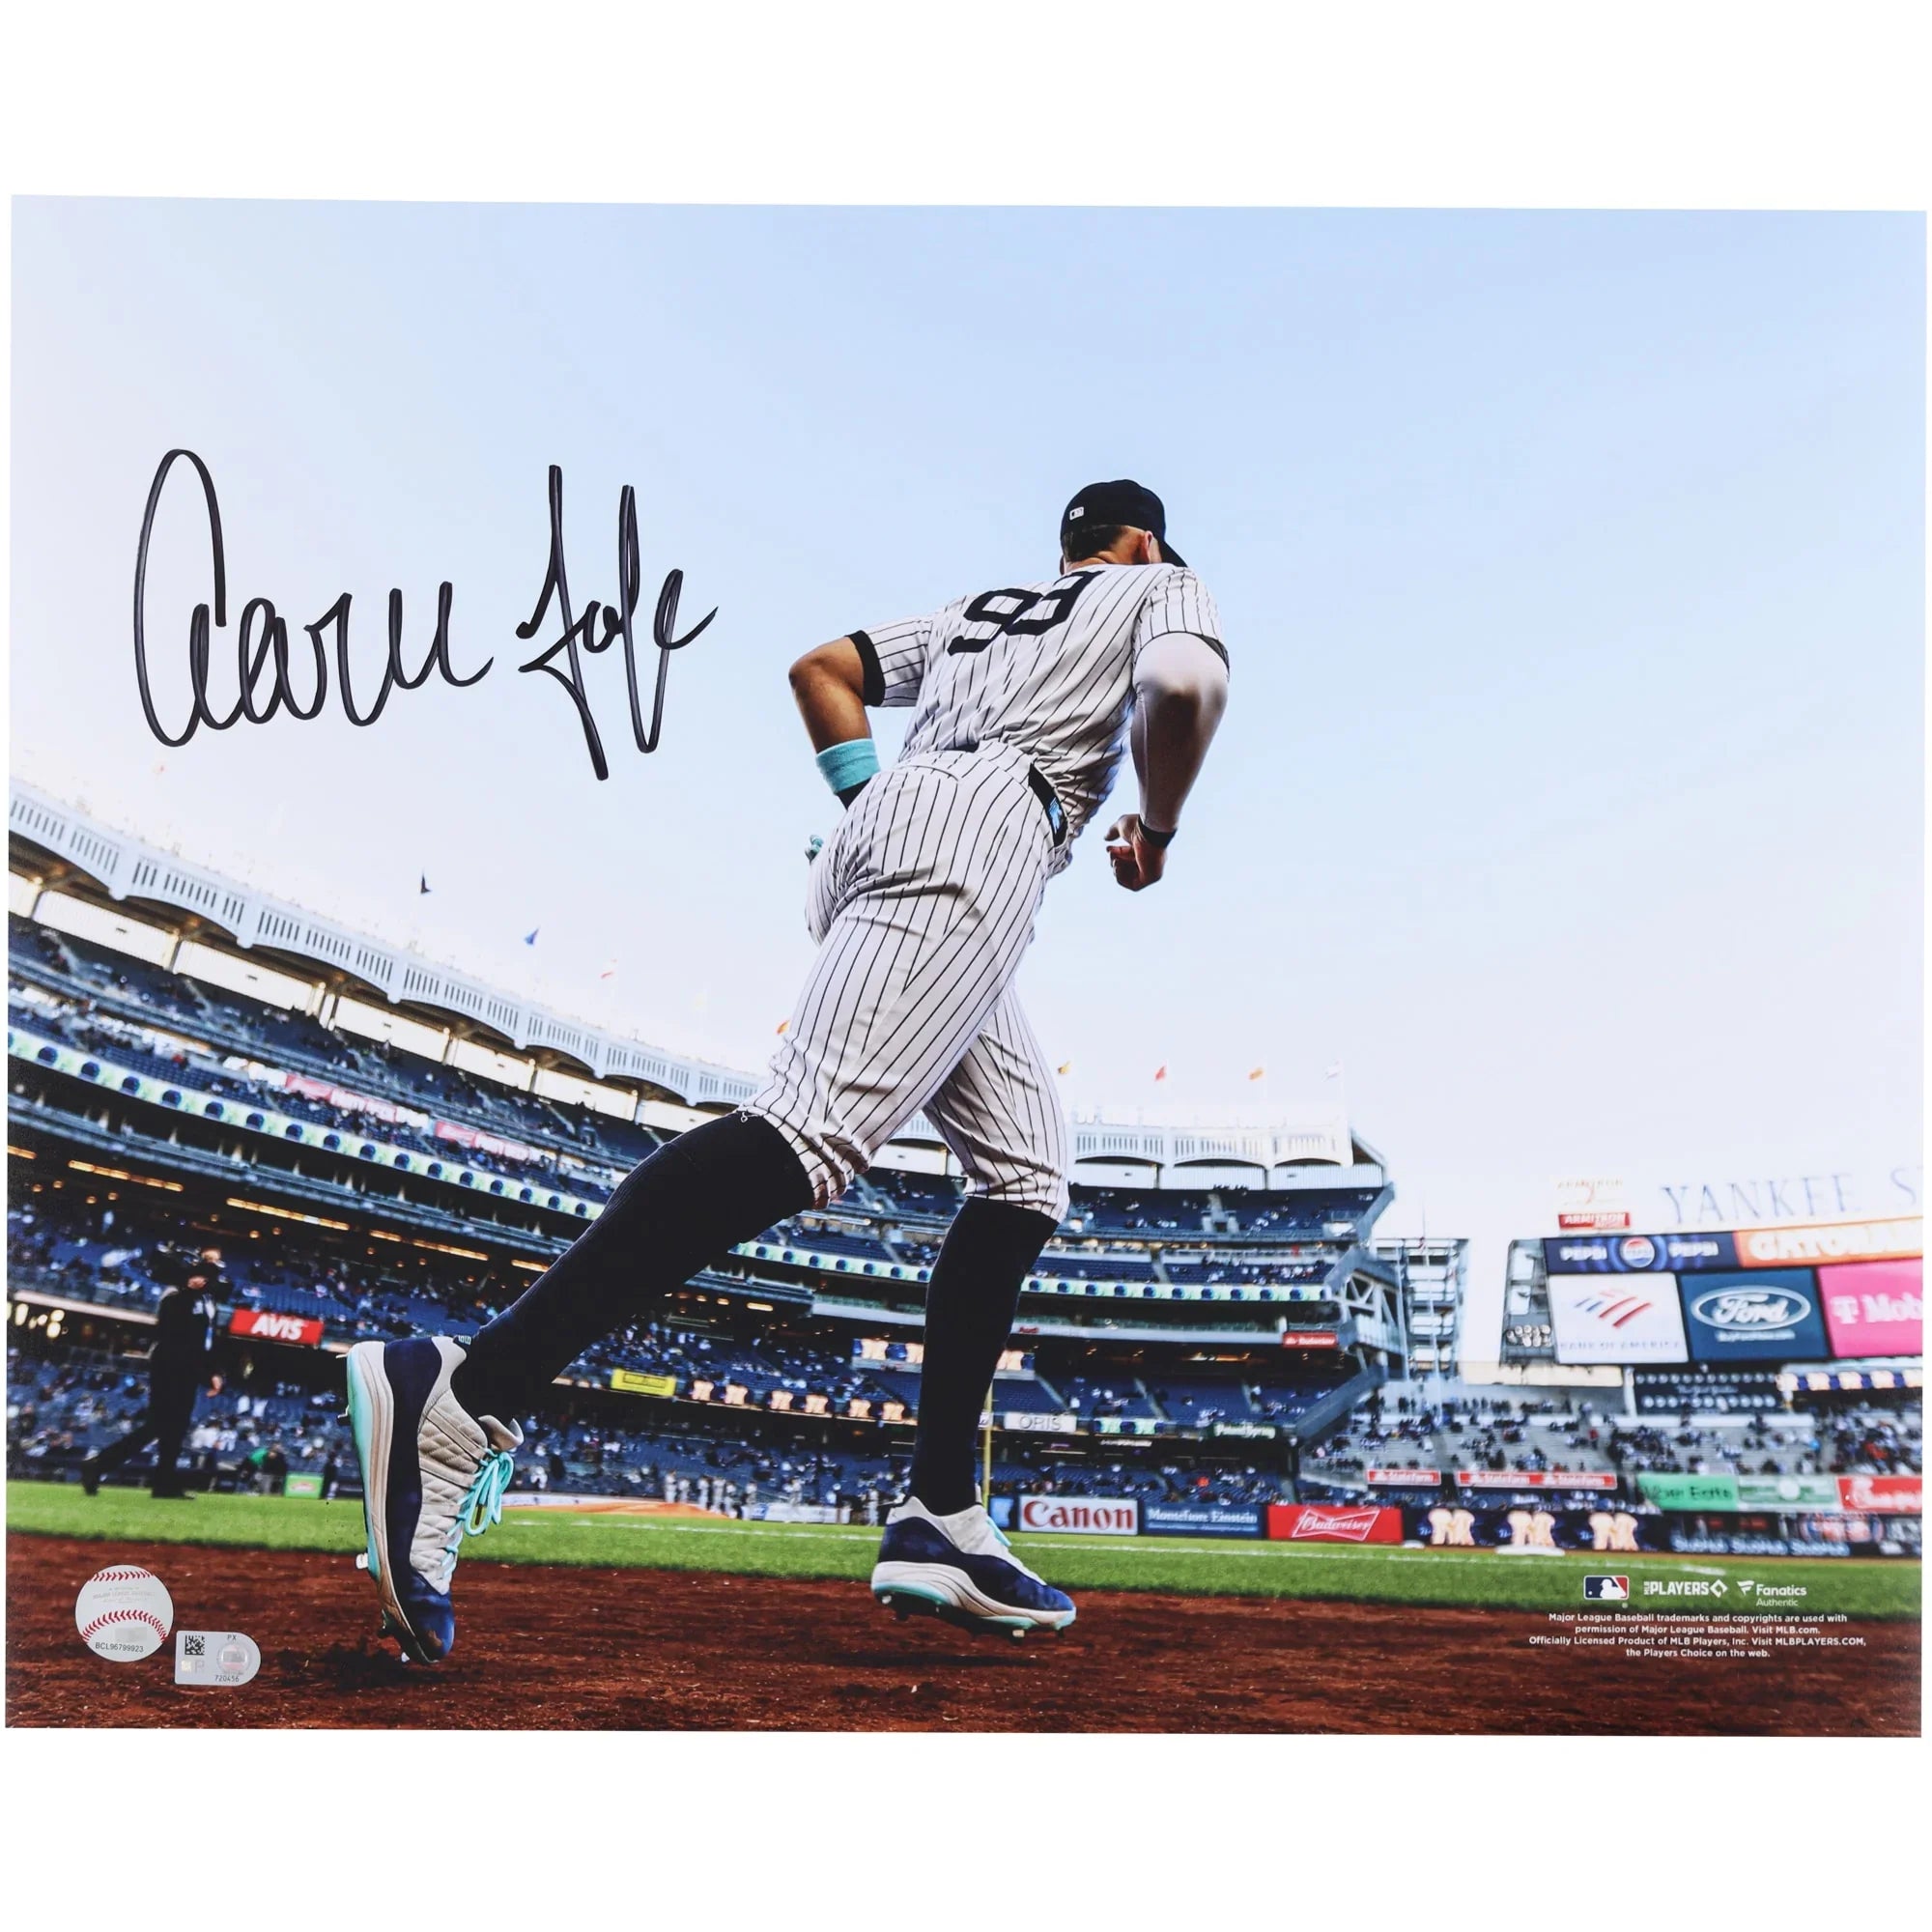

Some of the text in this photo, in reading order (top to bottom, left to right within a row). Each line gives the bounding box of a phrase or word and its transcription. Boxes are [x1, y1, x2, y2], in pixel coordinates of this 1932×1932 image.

[1559, 1245, 1607, 1261] PEPSI
[1712, 1293, 1789, 1323] Ford
[250, 1314, 303, 1341] AVIS
[1019, 1417, 1061, 1431] ORIS
[1023, 1500, 1135, 1530] Canon
[1300, 1511, 1374, 1532] Budweiser
[95, 1642, 144, 1653] BCL96799923
